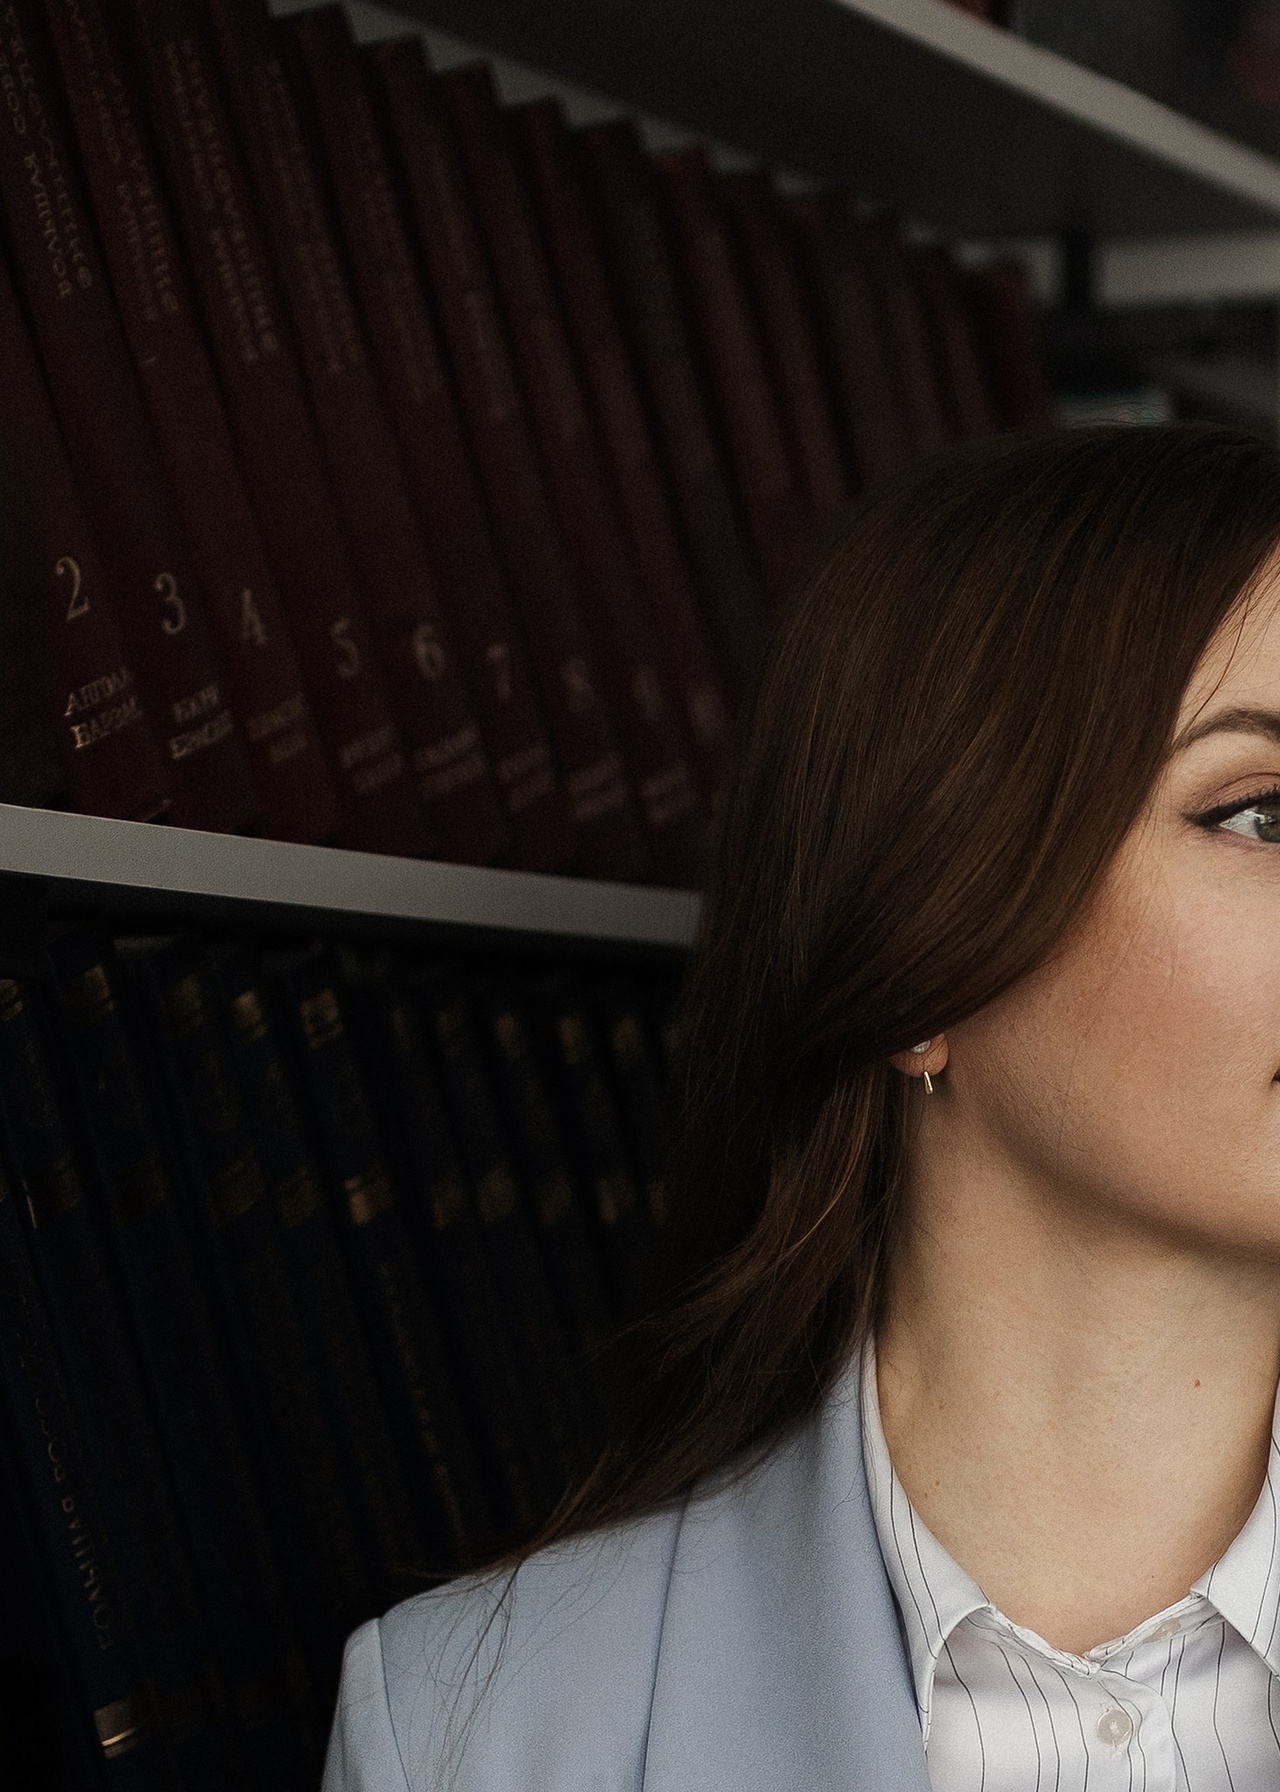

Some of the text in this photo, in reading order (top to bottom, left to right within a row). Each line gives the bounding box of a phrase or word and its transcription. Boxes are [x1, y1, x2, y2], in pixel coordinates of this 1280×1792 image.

[54, 555, 91, 623] 2
[154, 571, 188, 635] 3
[329, 616, 360, 681] 5
